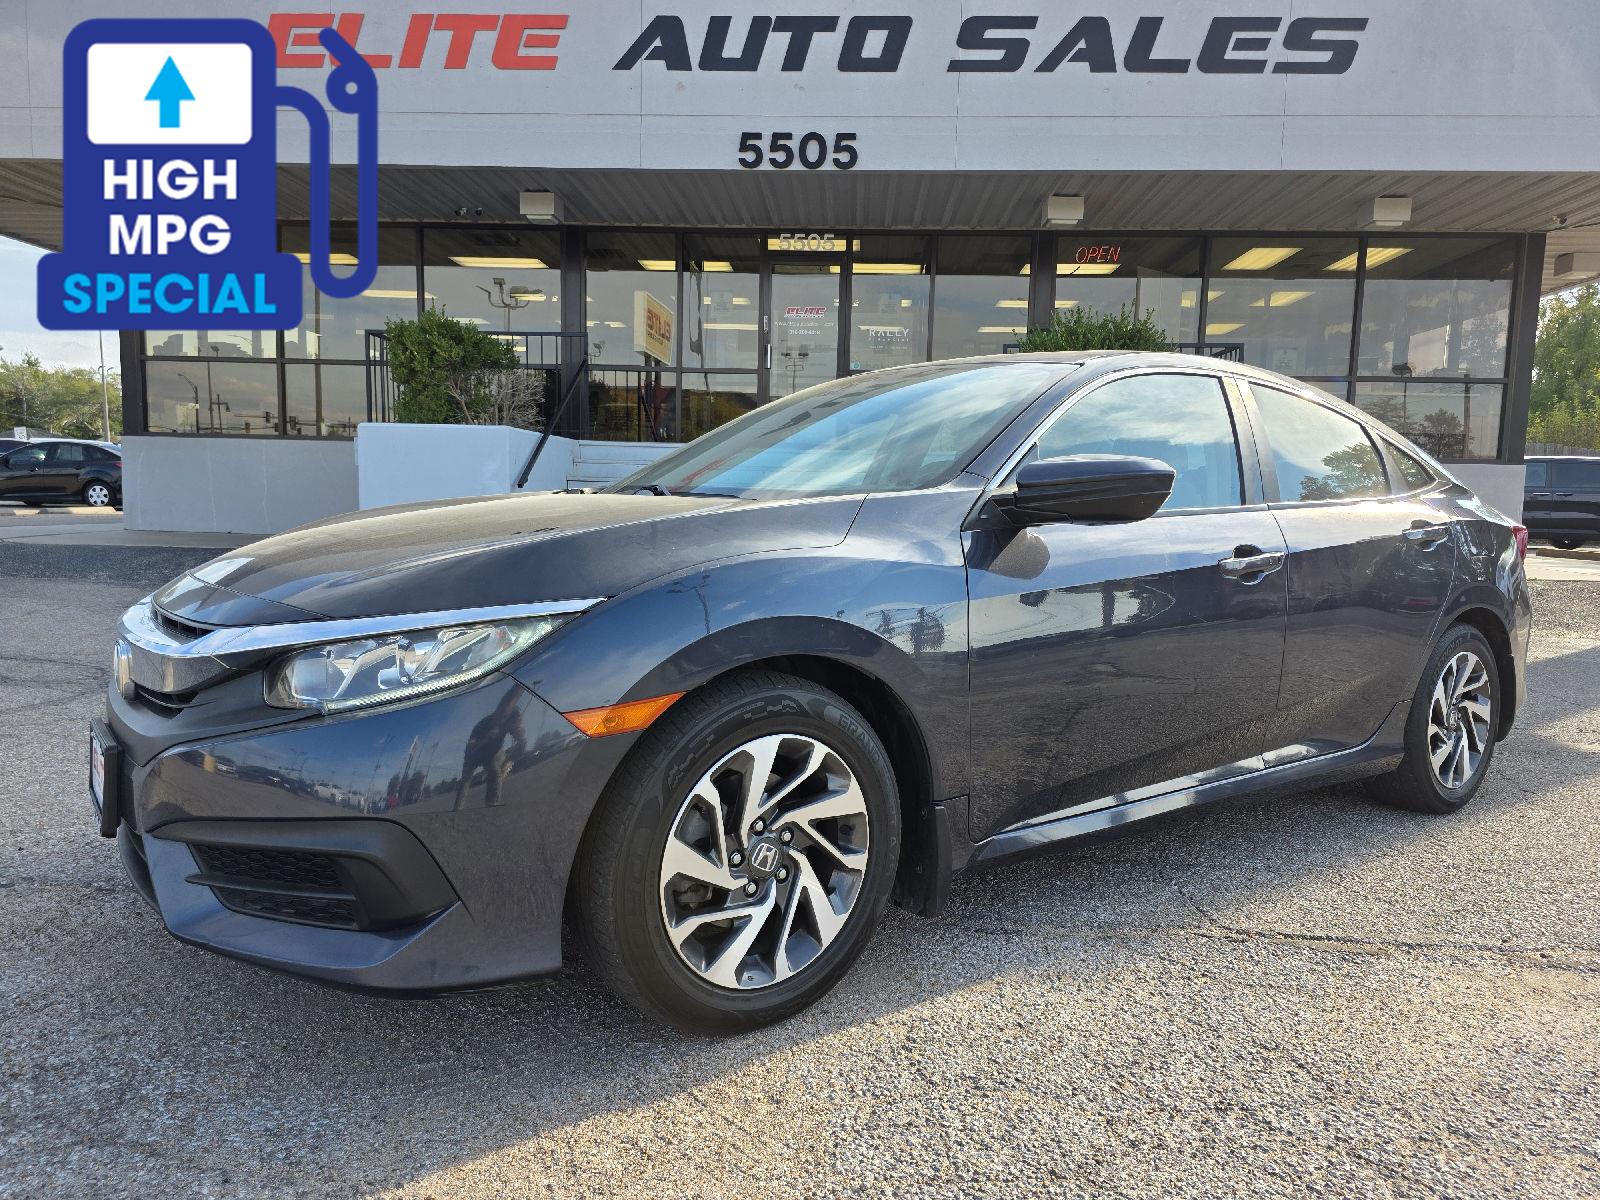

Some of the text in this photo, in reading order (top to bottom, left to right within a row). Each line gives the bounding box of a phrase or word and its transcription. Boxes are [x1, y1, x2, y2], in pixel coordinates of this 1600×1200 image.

[268, 13, 1370, 74] ELITE AUTO SALES
[738, 131, 858, 170] 5505
[778, 233, 836, 250] 5505
[1075, 246, 1121, 263] OPEN
